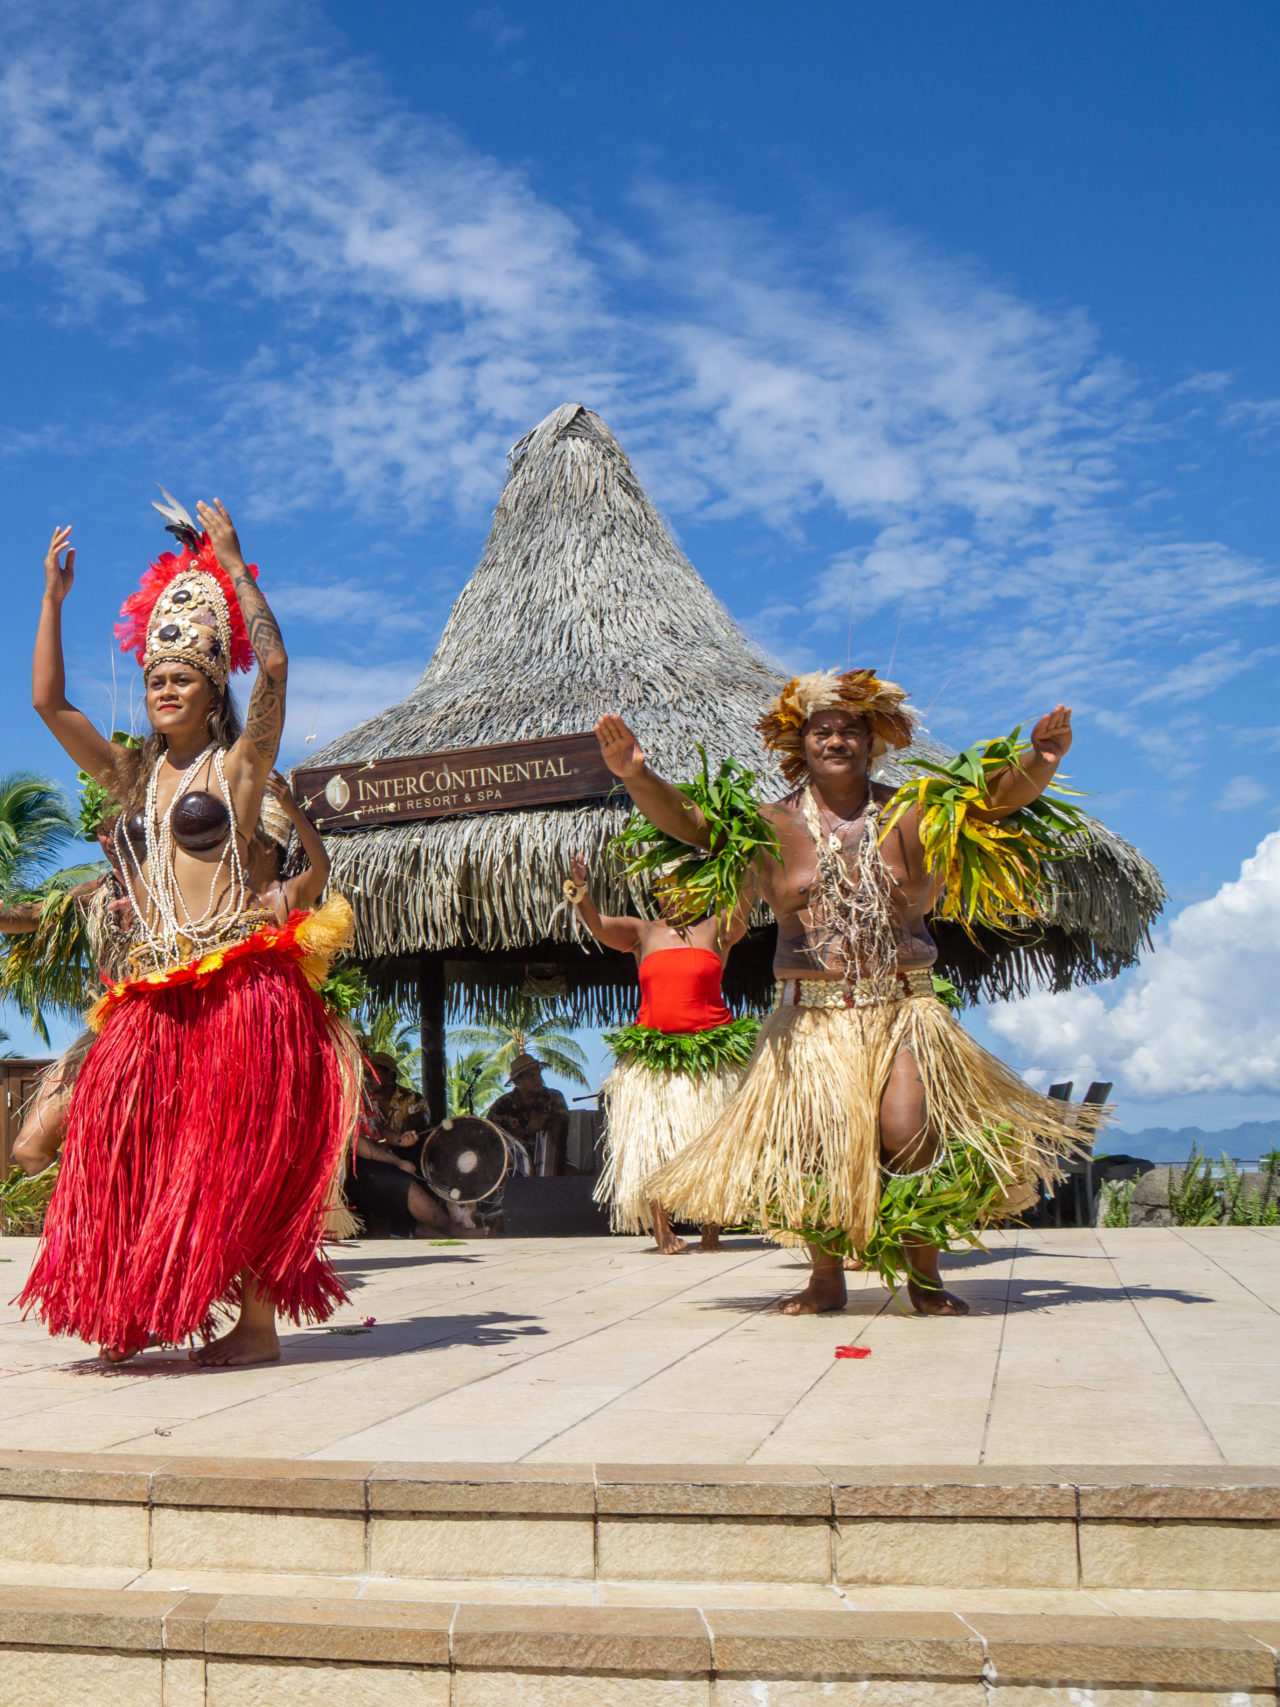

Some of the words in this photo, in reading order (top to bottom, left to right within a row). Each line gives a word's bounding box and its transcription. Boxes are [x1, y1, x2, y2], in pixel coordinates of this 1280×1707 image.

[361, 802, 401, 815] TAHII
[406, 795, 458, 810] RESORT
[464, 793, 472, 803] &
[477, 790, 502, 801] SPA
